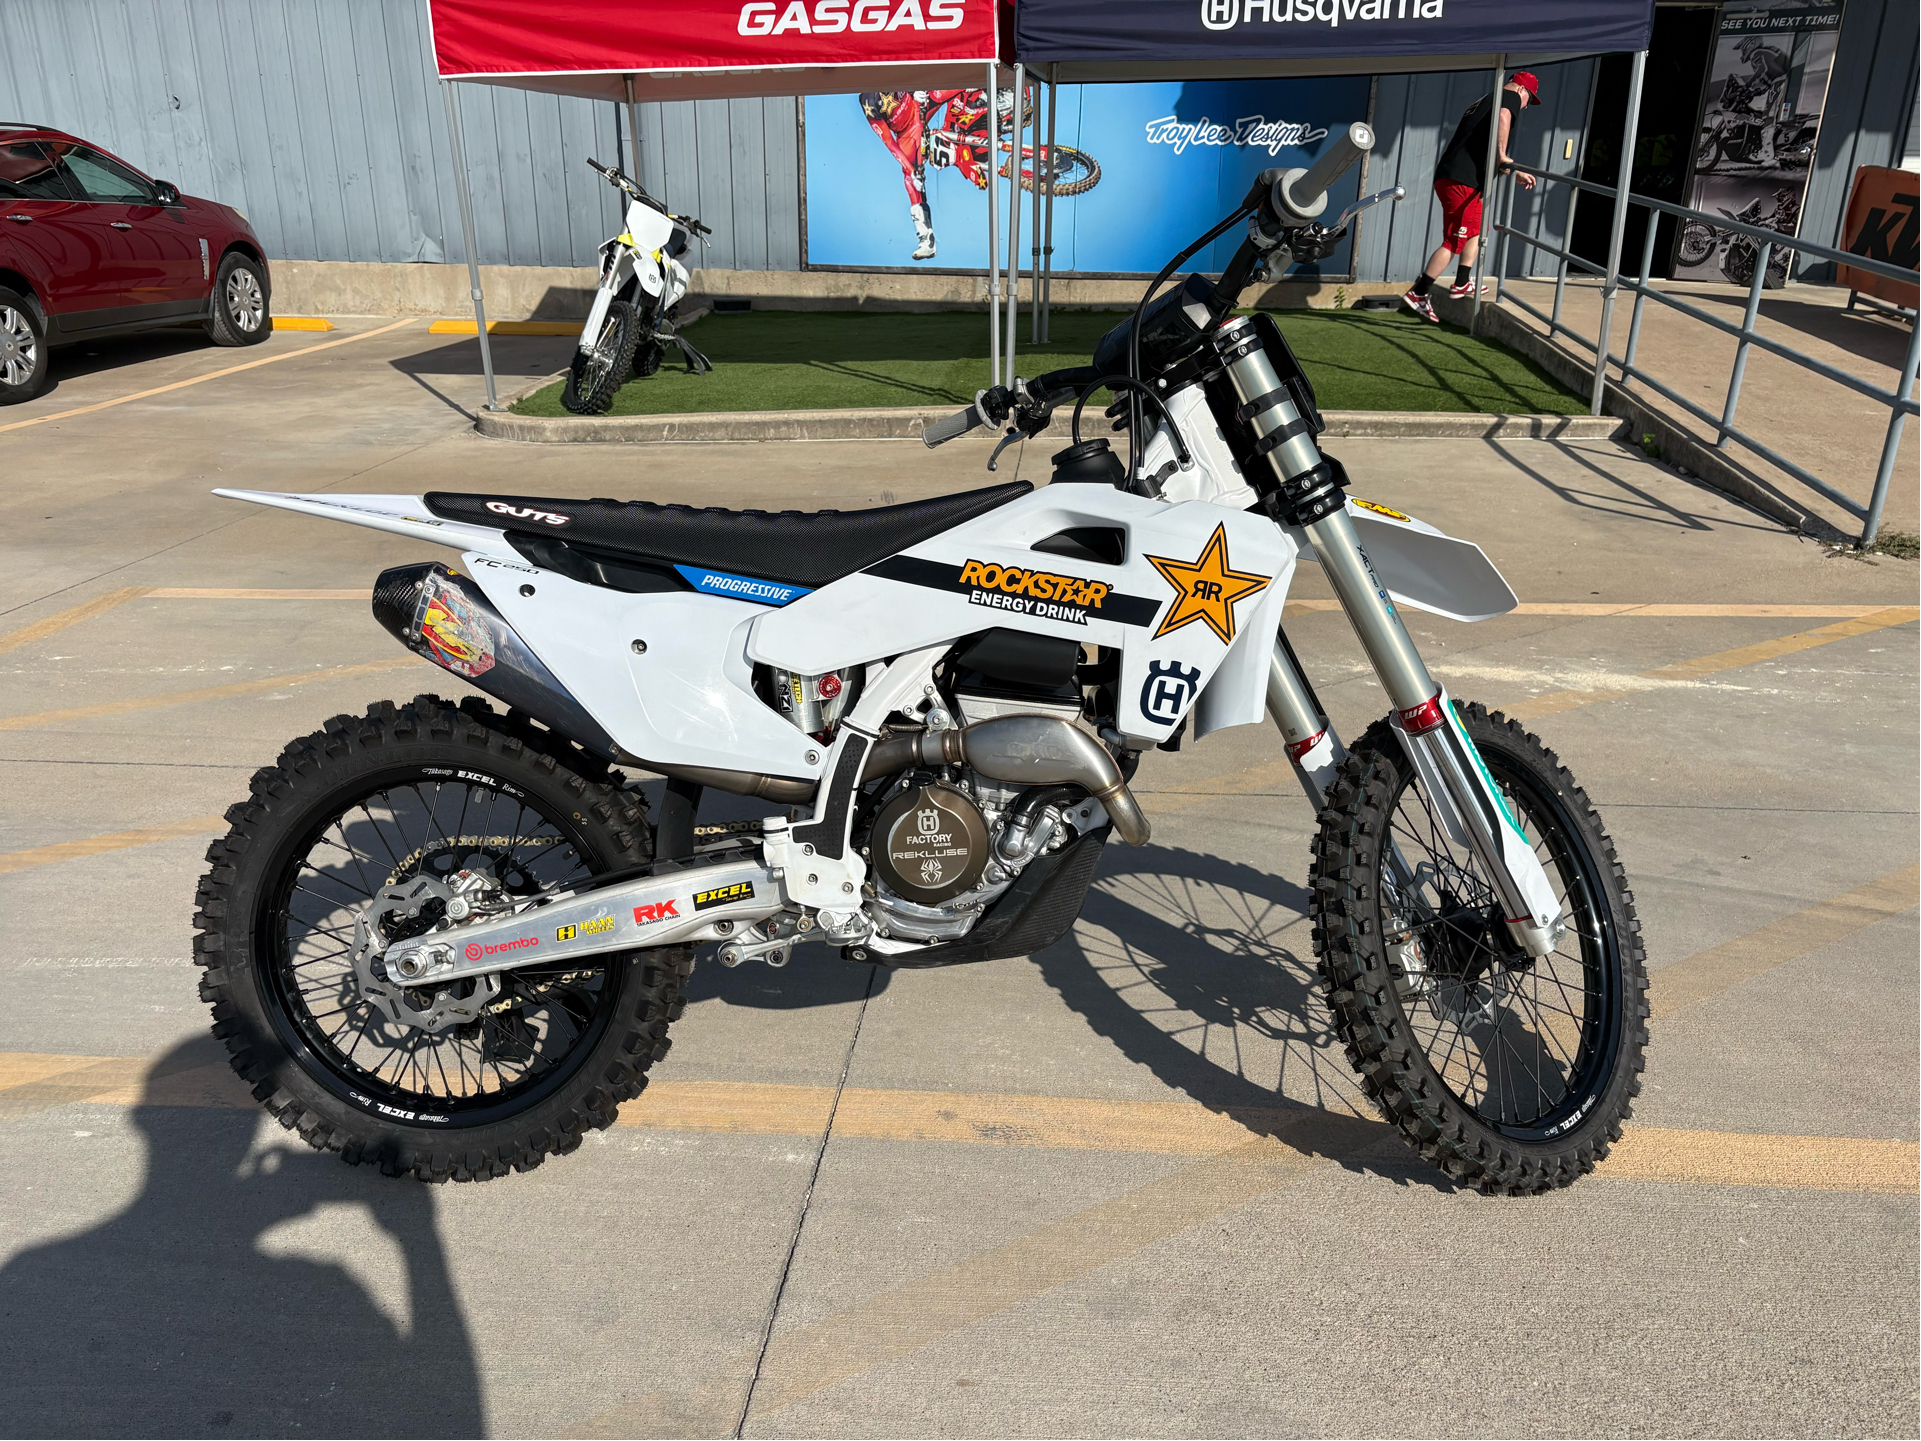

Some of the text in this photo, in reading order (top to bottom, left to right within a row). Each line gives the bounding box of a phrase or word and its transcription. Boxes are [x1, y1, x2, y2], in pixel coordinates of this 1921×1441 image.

[737, 0, 966, 36] GASGAS
[1243, 0, 1444, 28] Husqvarna
[1721, 14, 1840, 30] SEE YOU NEXT TIME!
[1146, 114, 1329, 157] Troy Lee Designs
[1849, 192, 1921, 270] KT
[485, 501, 571, 526] GUTS
[474, 557, 502, 568] FC
[1356, 544, 1375, 574] XACT
[701, 574, 793, 601] PROGRESSIVE
[958, 558, 1111, 609] ROCKSTAR
[969, 589, 1088, 624] ENERGY DRINK
[1404, 704, 1428, 720] WP
[457, 769, 497, 787] EXCEL
[906, 833, 953, 845] FACTORY
[892, 847, 968, 860] REKLUSE
[696, 883, 752, 904] EXCEL
[632, 899, 680, 924] RK
[664, 913, 681, 921] CHAIN
[579, 915, 615, 932] HAAN
[586, 924, 615, 936] WHEELS
[484, 936, 540, 955] brembo
[376, 1102, 416, 1121] EXCEL
[1559, 1110, 1582, 1130] EXCEL
